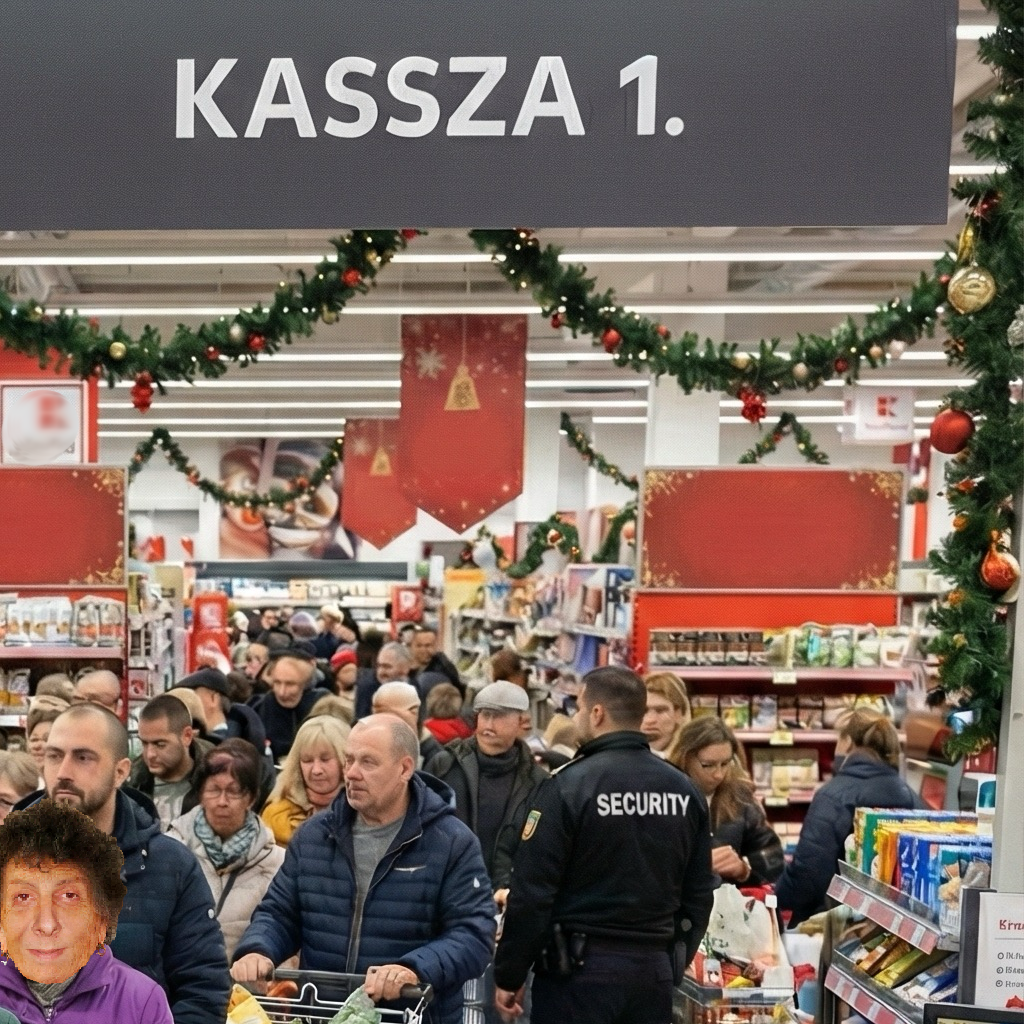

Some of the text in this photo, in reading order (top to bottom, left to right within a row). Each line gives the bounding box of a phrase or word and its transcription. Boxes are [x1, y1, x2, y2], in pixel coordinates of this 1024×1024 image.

[175, 54, 685, 139] KASSZA 1.
[596, 791, 690, 817] SECURITY
